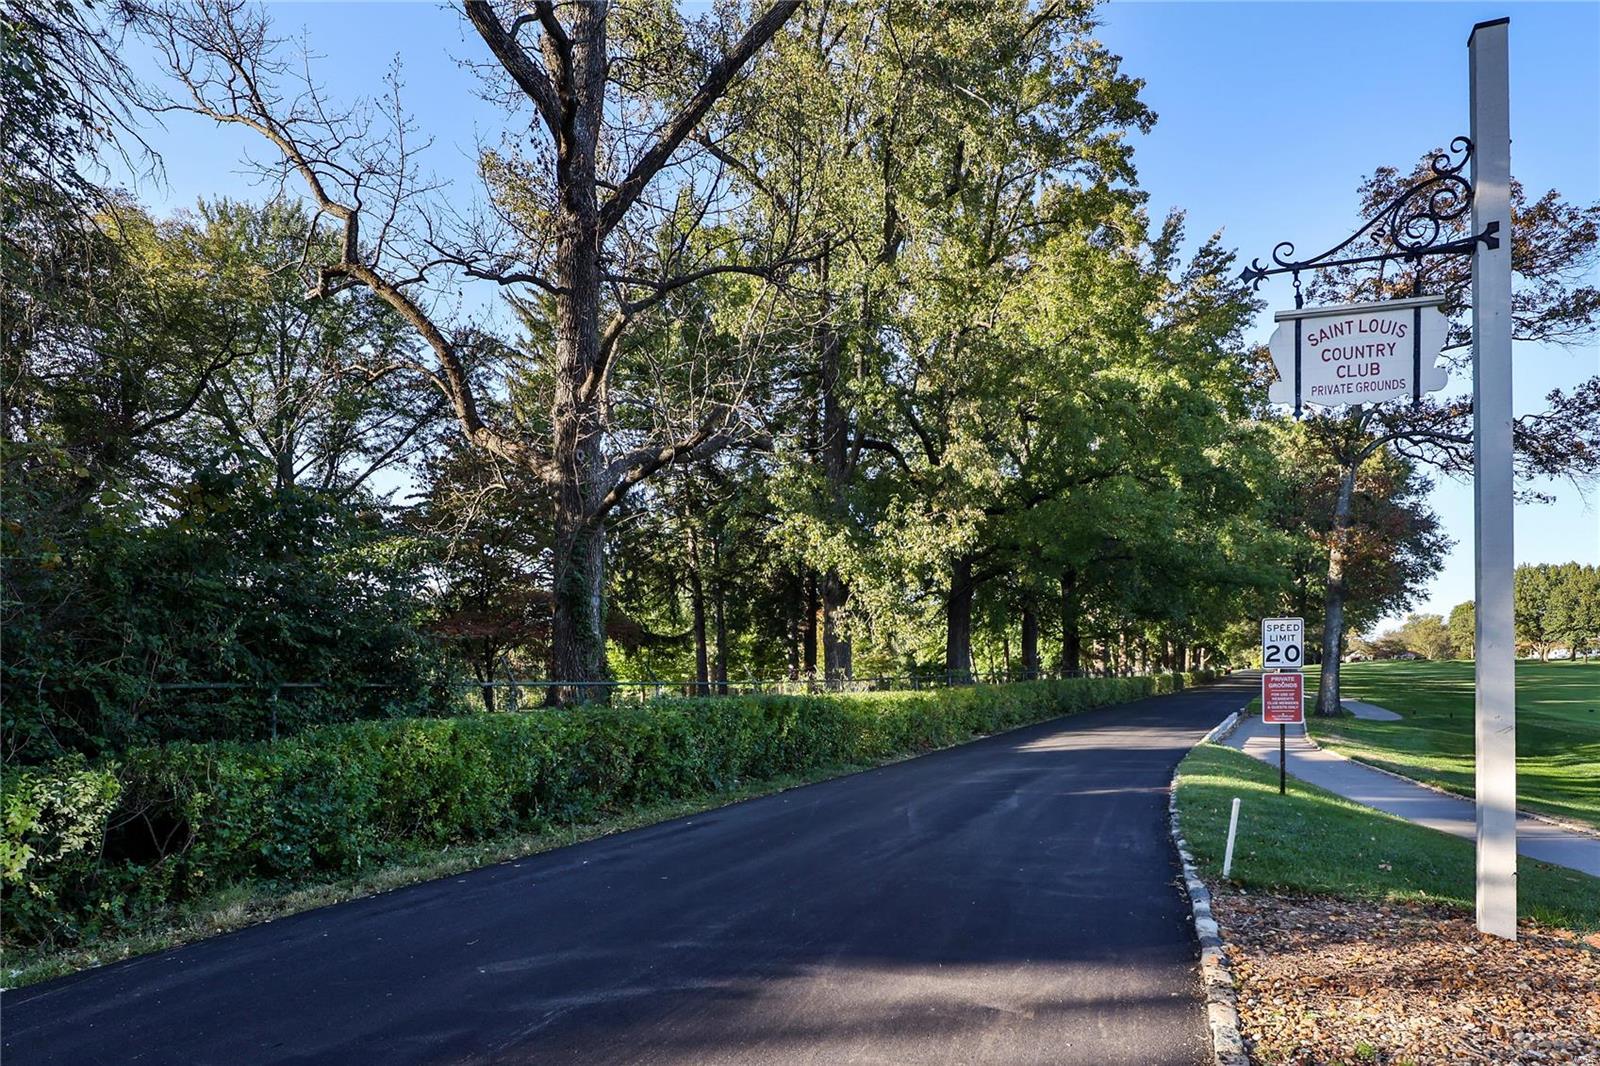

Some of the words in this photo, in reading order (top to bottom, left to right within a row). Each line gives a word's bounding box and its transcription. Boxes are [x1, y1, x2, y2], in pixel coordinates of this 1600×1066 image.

[1308, 320, 1354, 347] SAINT
[1359, 319, 1408, 338] LOUIS
[1321, 342, 1397, 362] COUNTRY
[1336, 362, 1381, 379] CLUB
[1311, 382, 1353, 396] PRIVATE
[1356, 379, 1406, 393] GROUNDS
[1266, 624, 1300, 632] SPEED
[1270, 634, 1296, 642] LIMIT
[1266, 645, 1300, 662] 20
